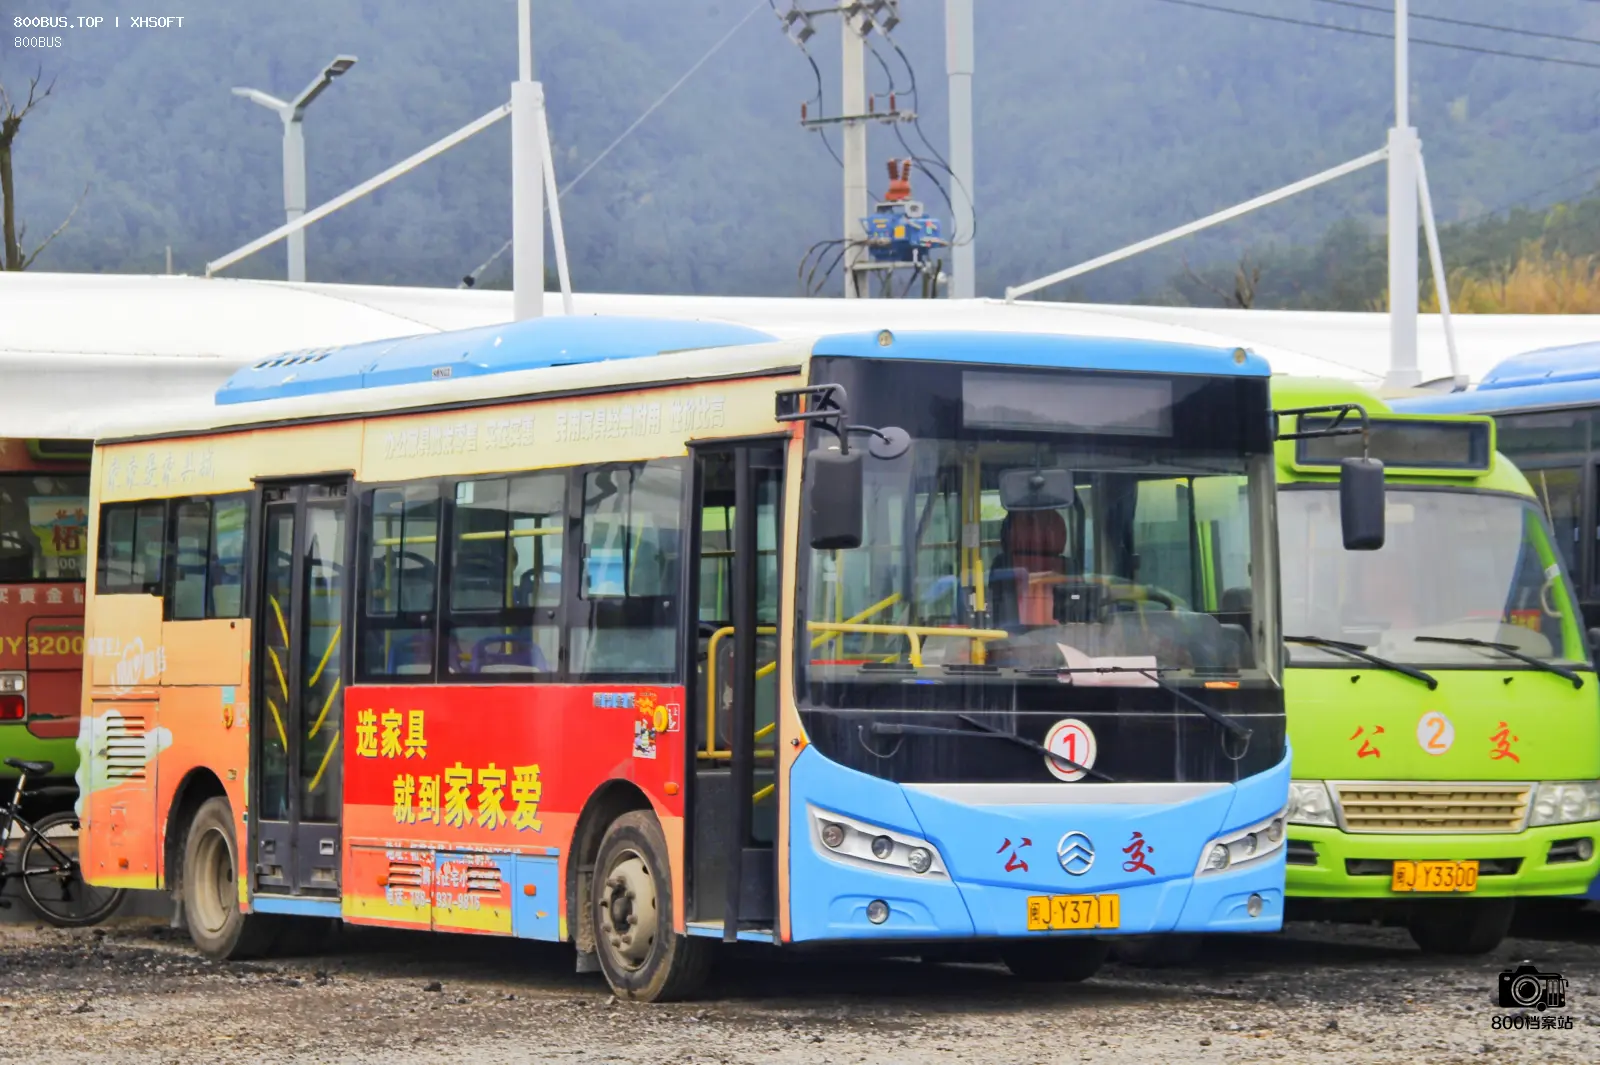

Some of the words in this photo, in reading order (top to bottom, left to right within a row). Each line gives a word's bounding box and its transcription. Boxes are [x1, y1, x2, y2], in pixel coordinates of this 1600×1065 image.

[355, 708, 428, 760] 选家具
[1349, 725, 1385, 760] 公
[1425, 717, 1446, 749] 2
[1488, 721, 1521, 763] 交
[392, 762, 544, 834] 就到家家爱
[996, 837, 1033, 873] 公
[1122, 831, 1156, 875] 交
